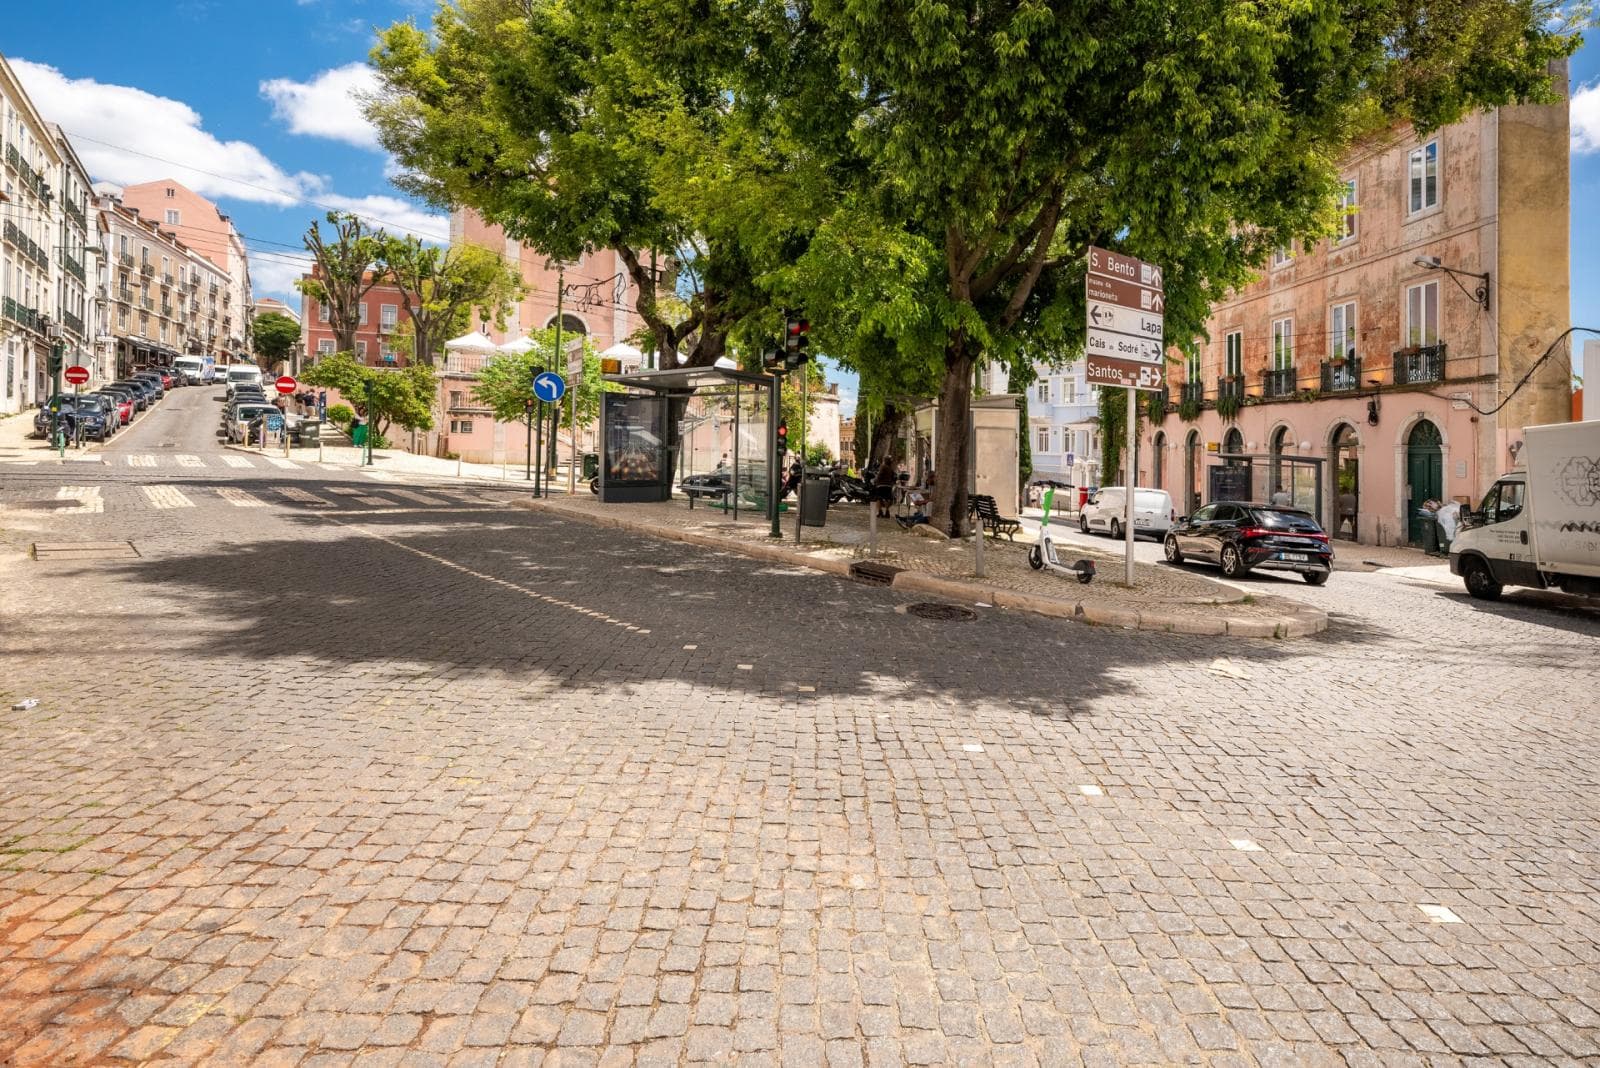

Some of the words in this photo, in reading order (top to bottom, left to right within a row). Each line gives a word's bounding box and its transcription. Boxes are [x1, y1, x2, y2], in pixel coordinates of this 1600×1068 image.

[1091, 252, 1101, 268] S.
[1107, 256, 1135, 277] Bento
[1141, 317, 1162, 335] Lapa
[1089, 337, 1106, 349] Cais
[1118, 341, 1139, 354] Sodré
[1087, 361, 1123, 380] Santos
